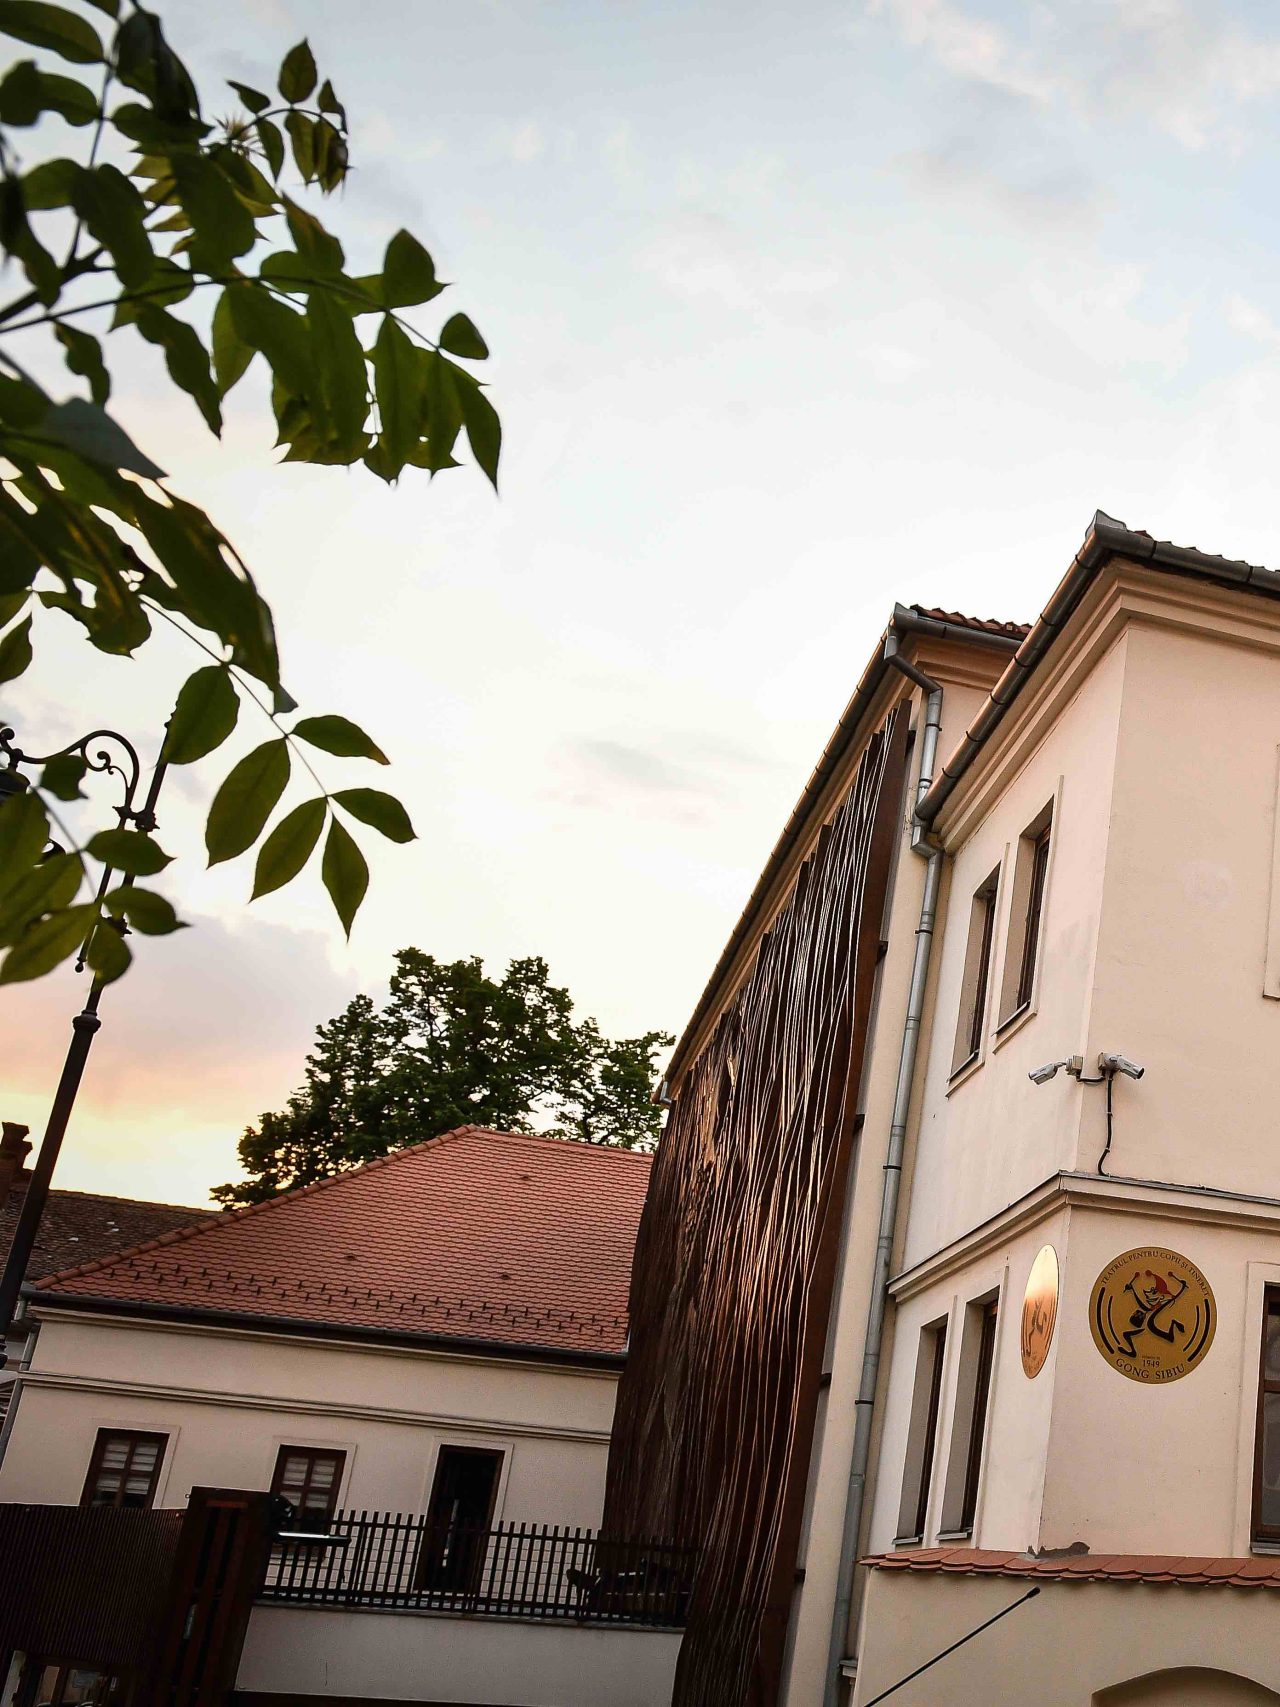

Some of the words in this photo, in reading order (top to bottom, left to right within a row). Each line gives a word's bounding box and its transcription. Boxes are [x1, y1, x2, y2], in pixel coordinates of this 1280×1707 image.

[1101, 1257, 1129, 1285] TEATRUL
[1128, 1250, 1159, 1261] PENTRU
[1160, 1251, 1181, 1264] COPII
[1189, 1267, 1210, 1297] TINERET
[1116, 1358, 1149, 1379] GONG
[1155, 1364, 1185, 1380] SIBIU
[1142, 1359, 1160, 1367] 1949
